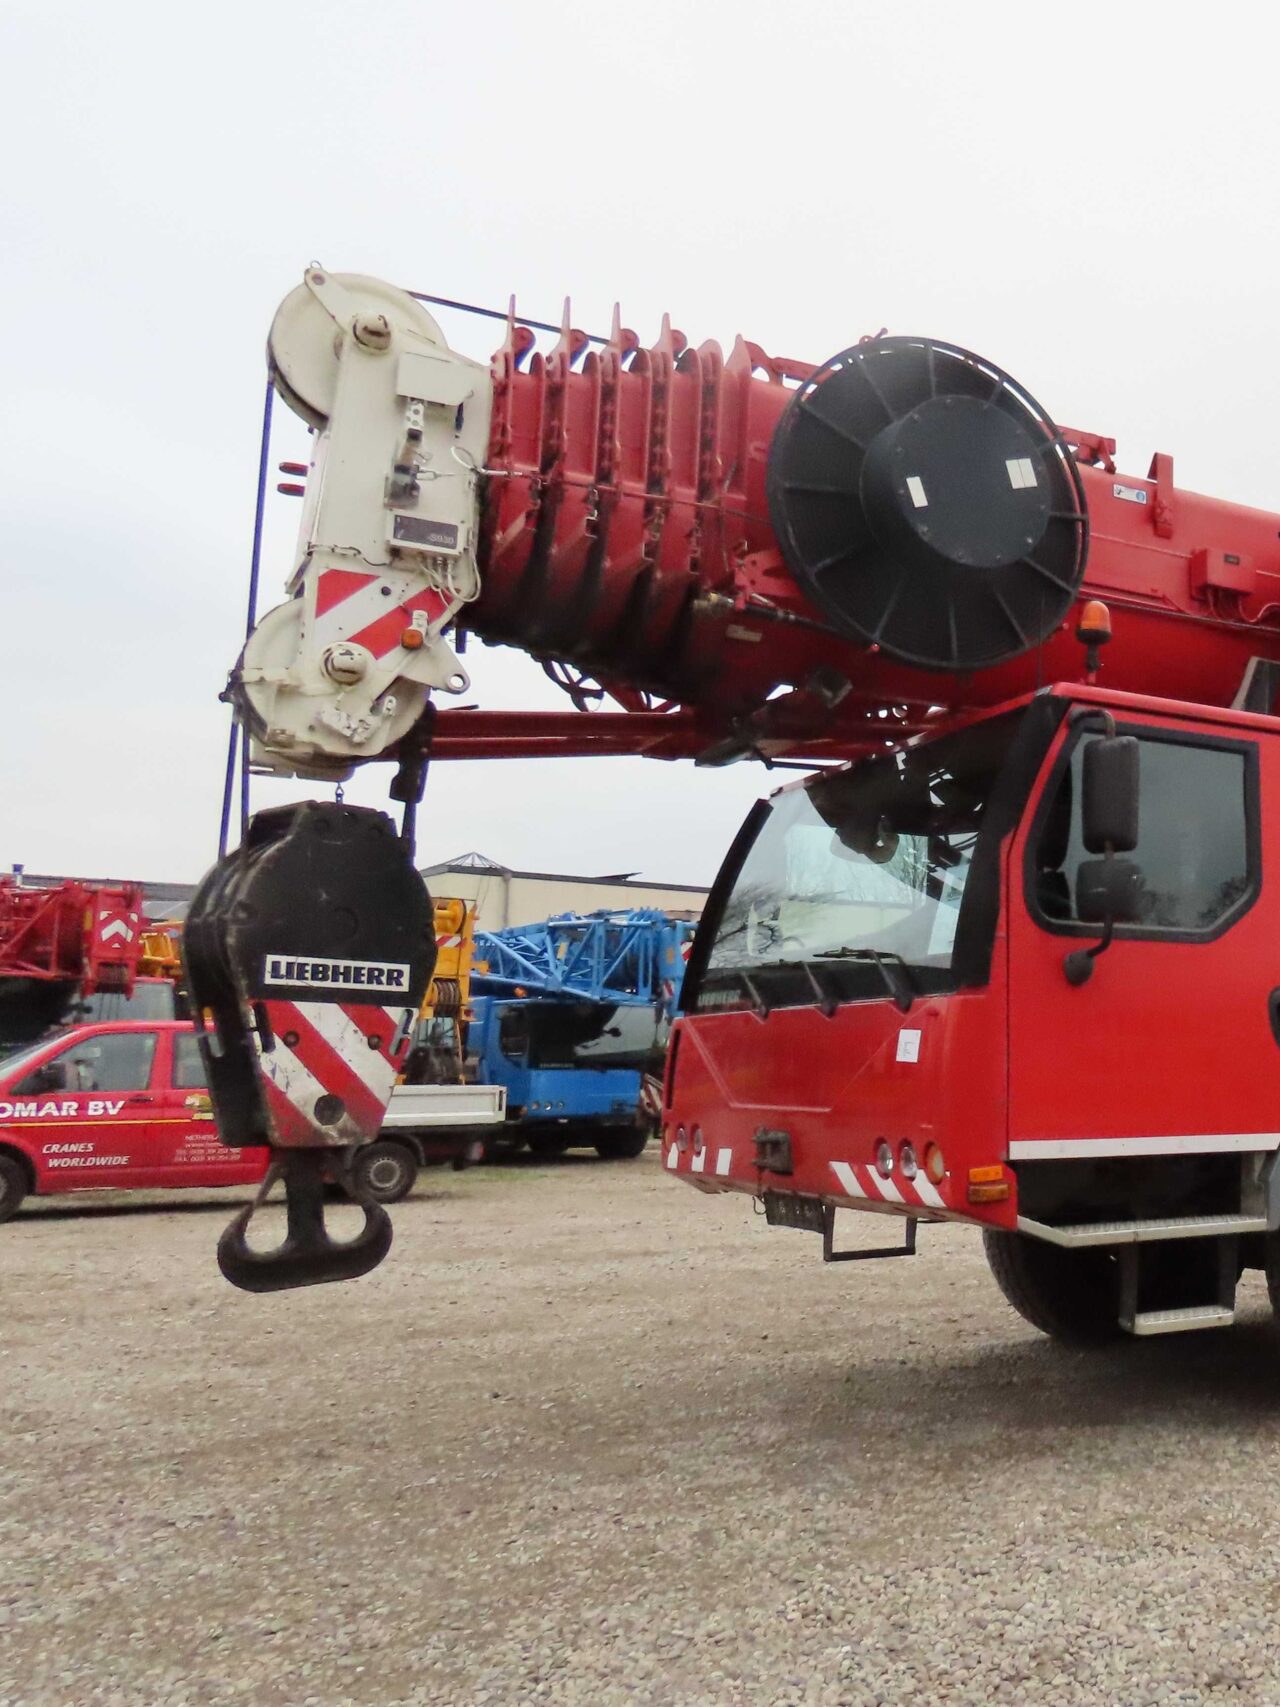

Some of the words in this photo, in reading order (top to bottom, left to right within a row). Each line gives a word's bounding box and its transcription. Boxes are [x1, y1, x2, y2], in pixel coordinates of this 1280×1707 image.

[270, 960, 404, 987] LIEBHERR
[88, 1101, 125, 1116] BV
[42, 1143, 95, 1154] CRANES
[48, 1156, 130, 1168] WORLDWIDE
